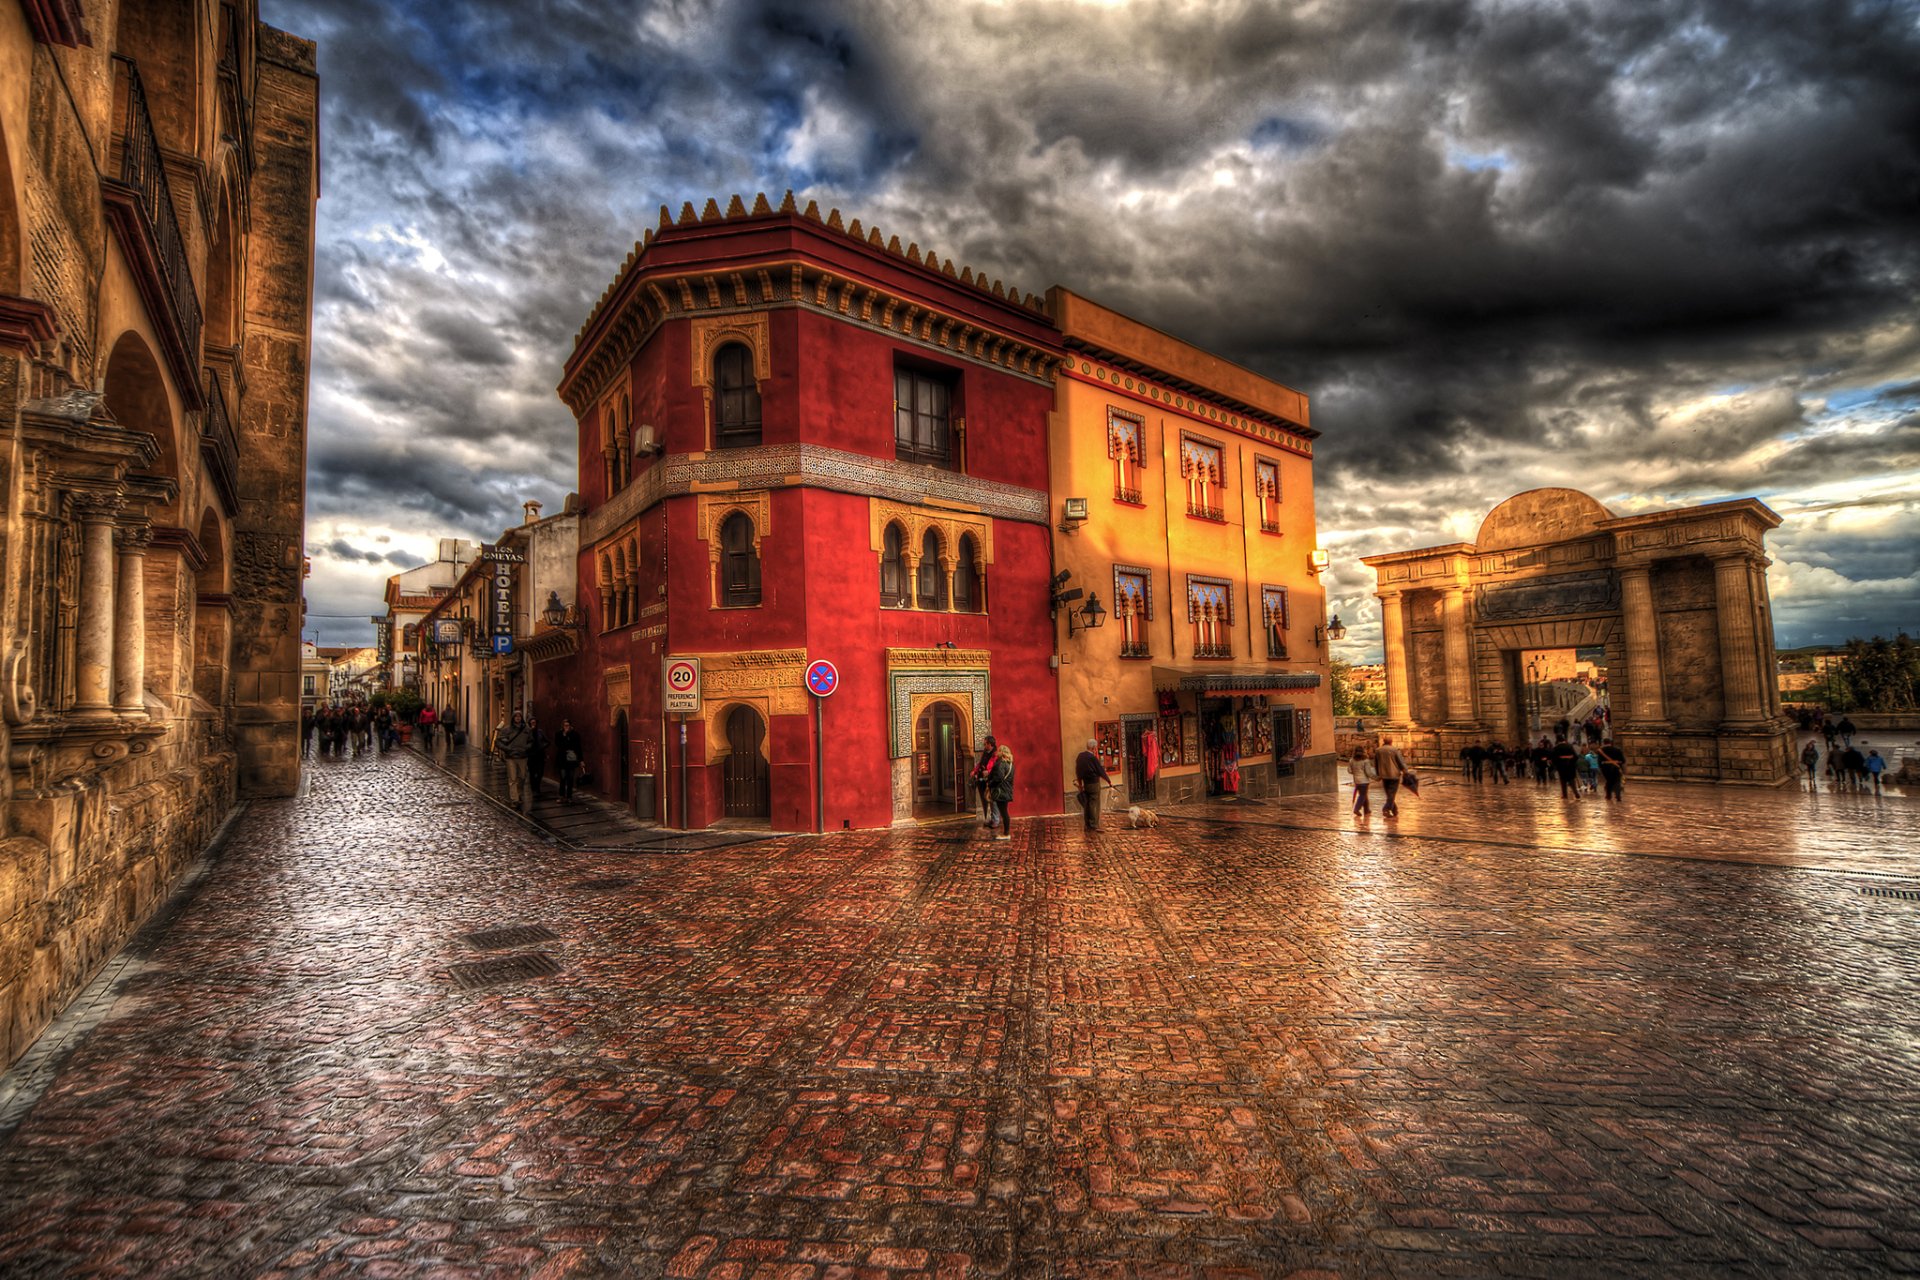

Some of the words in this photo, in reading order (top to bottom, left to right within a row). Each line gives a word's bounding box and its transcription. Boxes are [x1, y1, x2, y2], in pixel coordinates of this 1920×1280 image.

[484, 552, 524, 561] OMEYAS
[496, 563, 511, 625] HOTEL
[497, 637, 509, 650] P
[673, 671, 691, 682] 20
